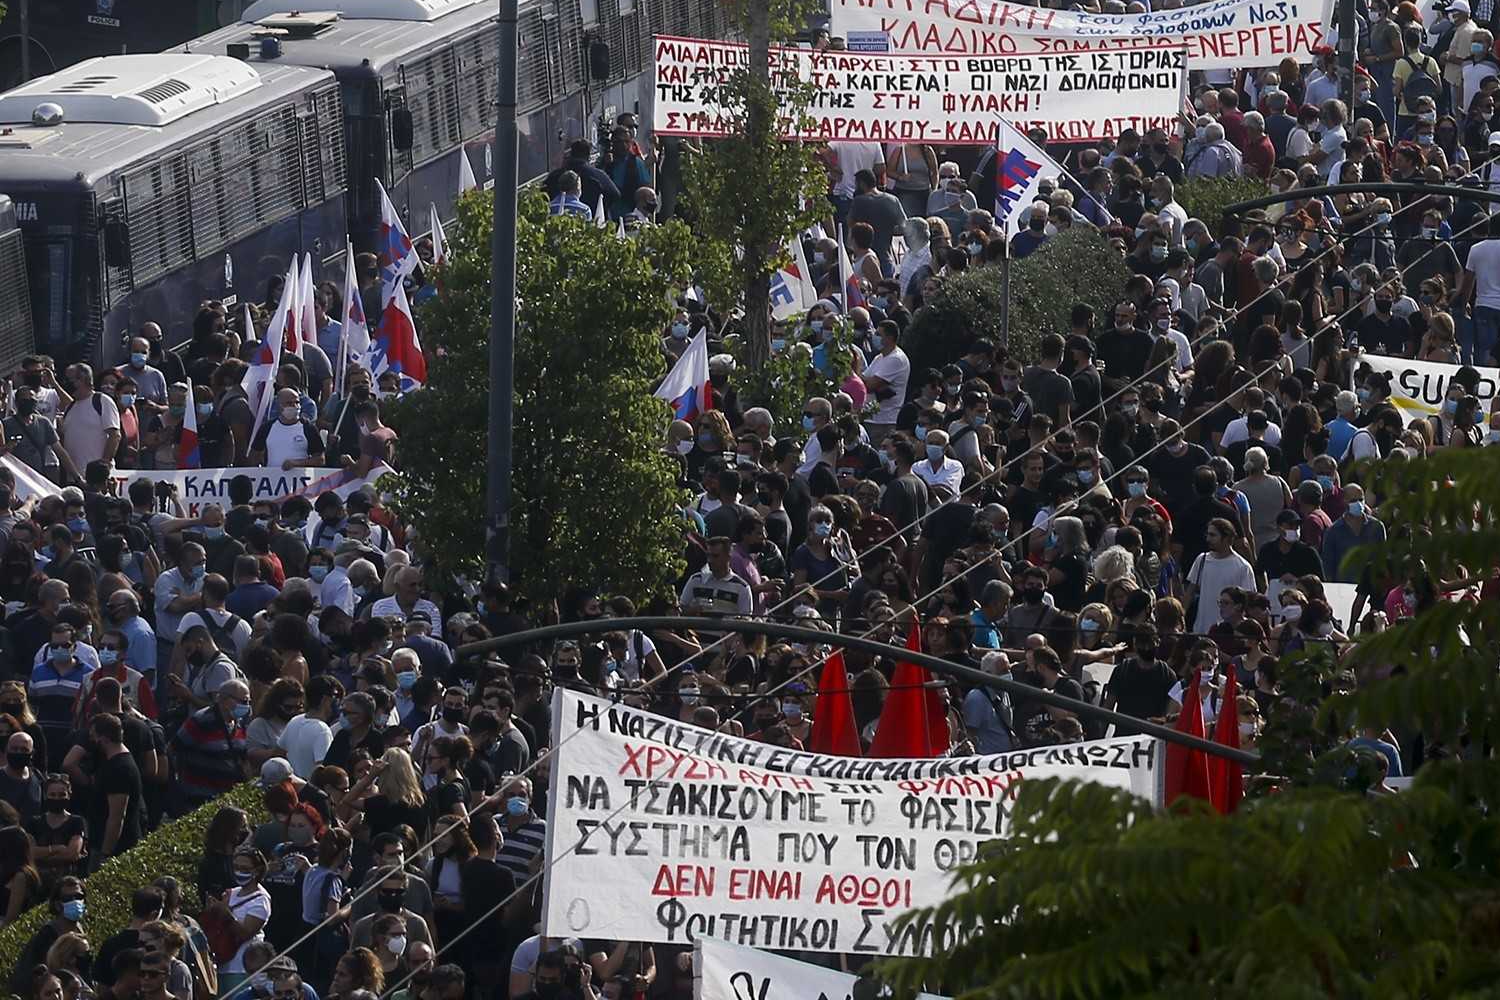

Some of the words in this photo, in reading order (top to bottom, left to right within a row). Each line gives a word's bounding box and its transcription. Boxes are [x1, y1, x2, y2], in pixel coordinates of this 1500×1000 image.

[1249, 1, 1299, 26] Ναζι
[881, 17, 1018, 55] ΚΛΑΔΙΚΟ
[1184, 21, 1325, 60] ΕΝΕΡΓΕΙΑΣ
[967, 57, 1032, 73] ΒΟΘΡΟ
[1038, 54, 1083, 72] ΤΗΣ
[1091, 50, 1187, 73] ΙΣΤΟΡΙΑΣ
[657, 64, 688, 85] ΚΑΙ
[846, 73, 949, 93] ΚΑΓΚΕΛΑ!
[971, 74, 992, 92] ΟΙ
[1005, 74, 1048, 92] ΝΑΖΙ
[1058, 72, 1178, 94] ΔΟΛΟΦΟΝΟΙ
[657, 83, 696, 103] ΤΗΣ
[873, 93, 920, 110] ΣΤΗ
[942, 93, 1041, 115] ΦΥΛΑΚΗ!
[576, 699, 600, 731] Η
[608, 708, 762, 767] ΝΑΖΙΣΤΙΚΗ
[765, 749, 980, 782] ΕΓΚΛΗΜΑΤΙΚΗ
[618, 742, 728, 780] ΧΡΥΣΗ
[738, 768, 816, 791] ΑΥΓΗ
[824, 781, 883, 795] ΣΤΗ
[897, 770, 1025, 801] ΦΥΛΑΚΗ
[565, 774, 610, 811] ΝΑ
[624, 778, 828, 824] ΤΣΑΚΙΣΟΥΜΕ
[840, 798, 876, 827] ΤΟ
[574, 818, 751, 862] ΣΥΣΤΗΜΑ
[776, 831, 839, 867] ΠΟΥ
[856, 835, 917, 872] ΤΟΝ
[651, 863, 716, 897] ΔΕΝ
[728, 868, 802, 901] ΕΙΝΑΙ
[815, 873, 912, 909] ΑΘΩΟΙ
[656, 896, 840, 951] ΦΟΙΤΗΤΙΚΟΙ
